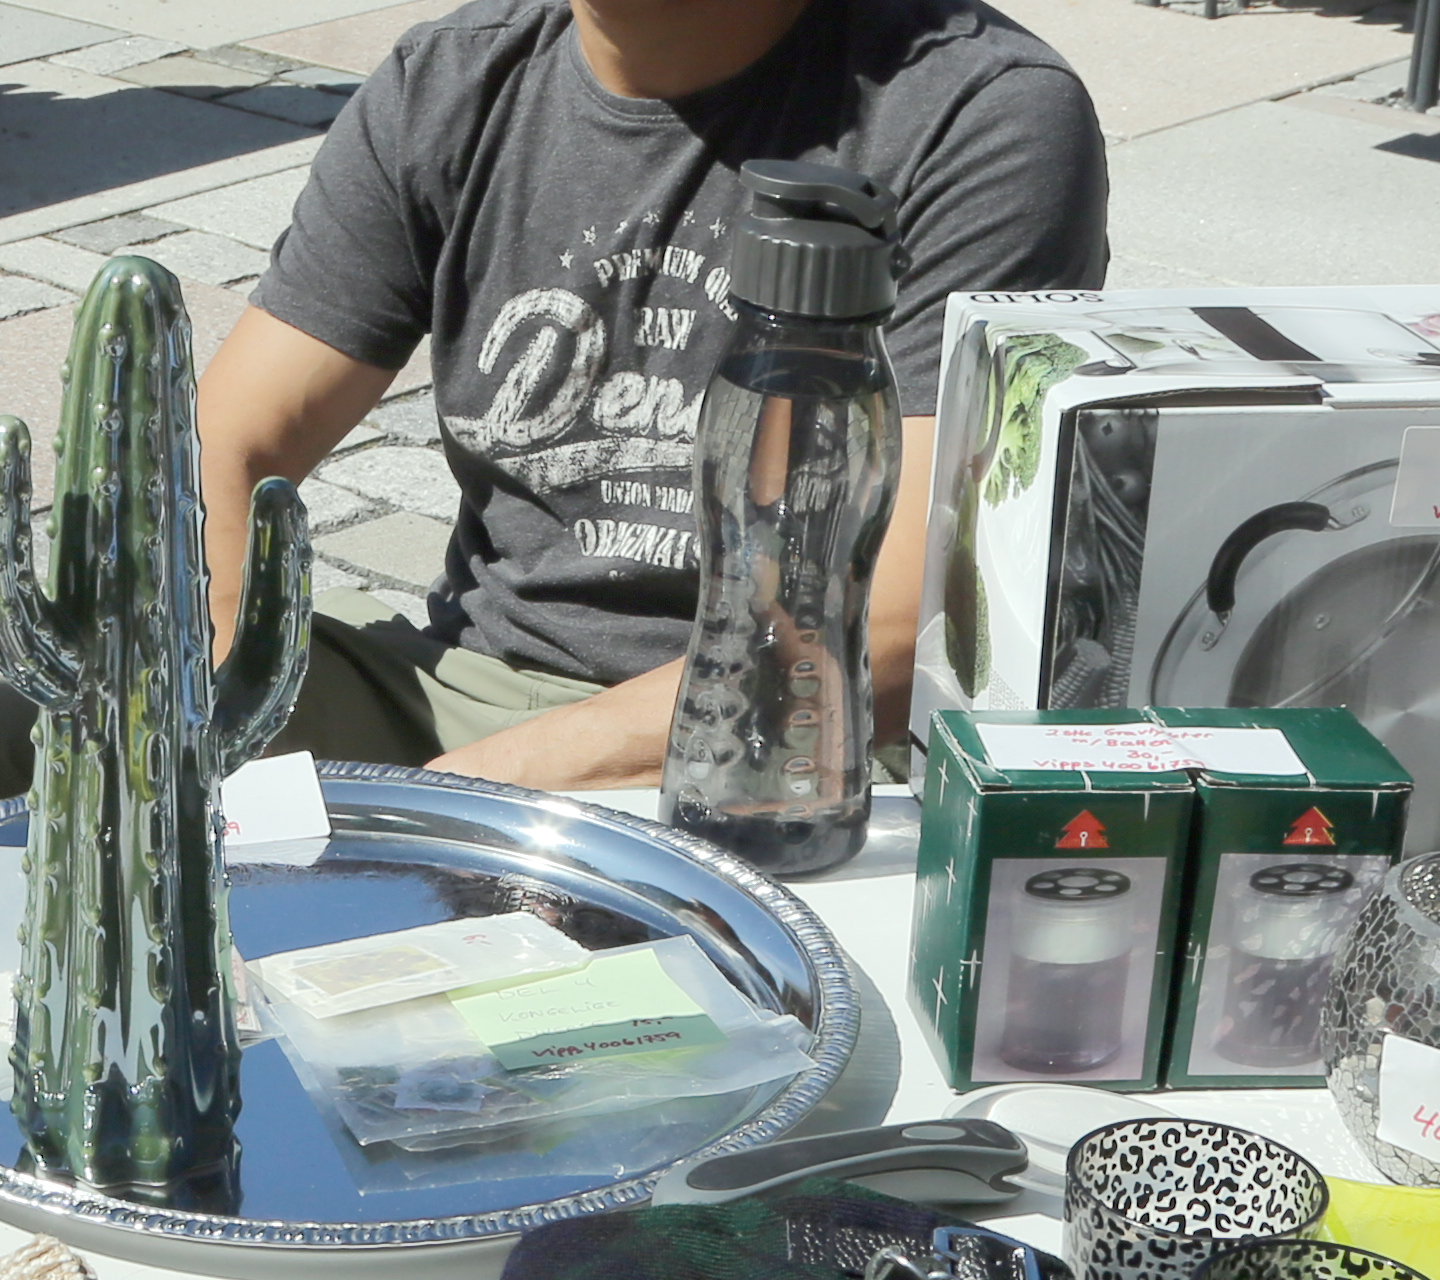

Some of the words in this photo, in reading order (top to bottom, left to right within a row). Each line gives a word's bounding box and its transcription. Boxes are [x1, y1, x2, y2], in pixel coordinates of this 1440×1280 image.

[593, 245, 706, 287] PREMIUM
[970, 292, 1105, 304] SOLID
[634, 307, 697, 350] RAW
[600, 480, 651, 507] UNION
[583, 1030, 682, 1050] 40061759
